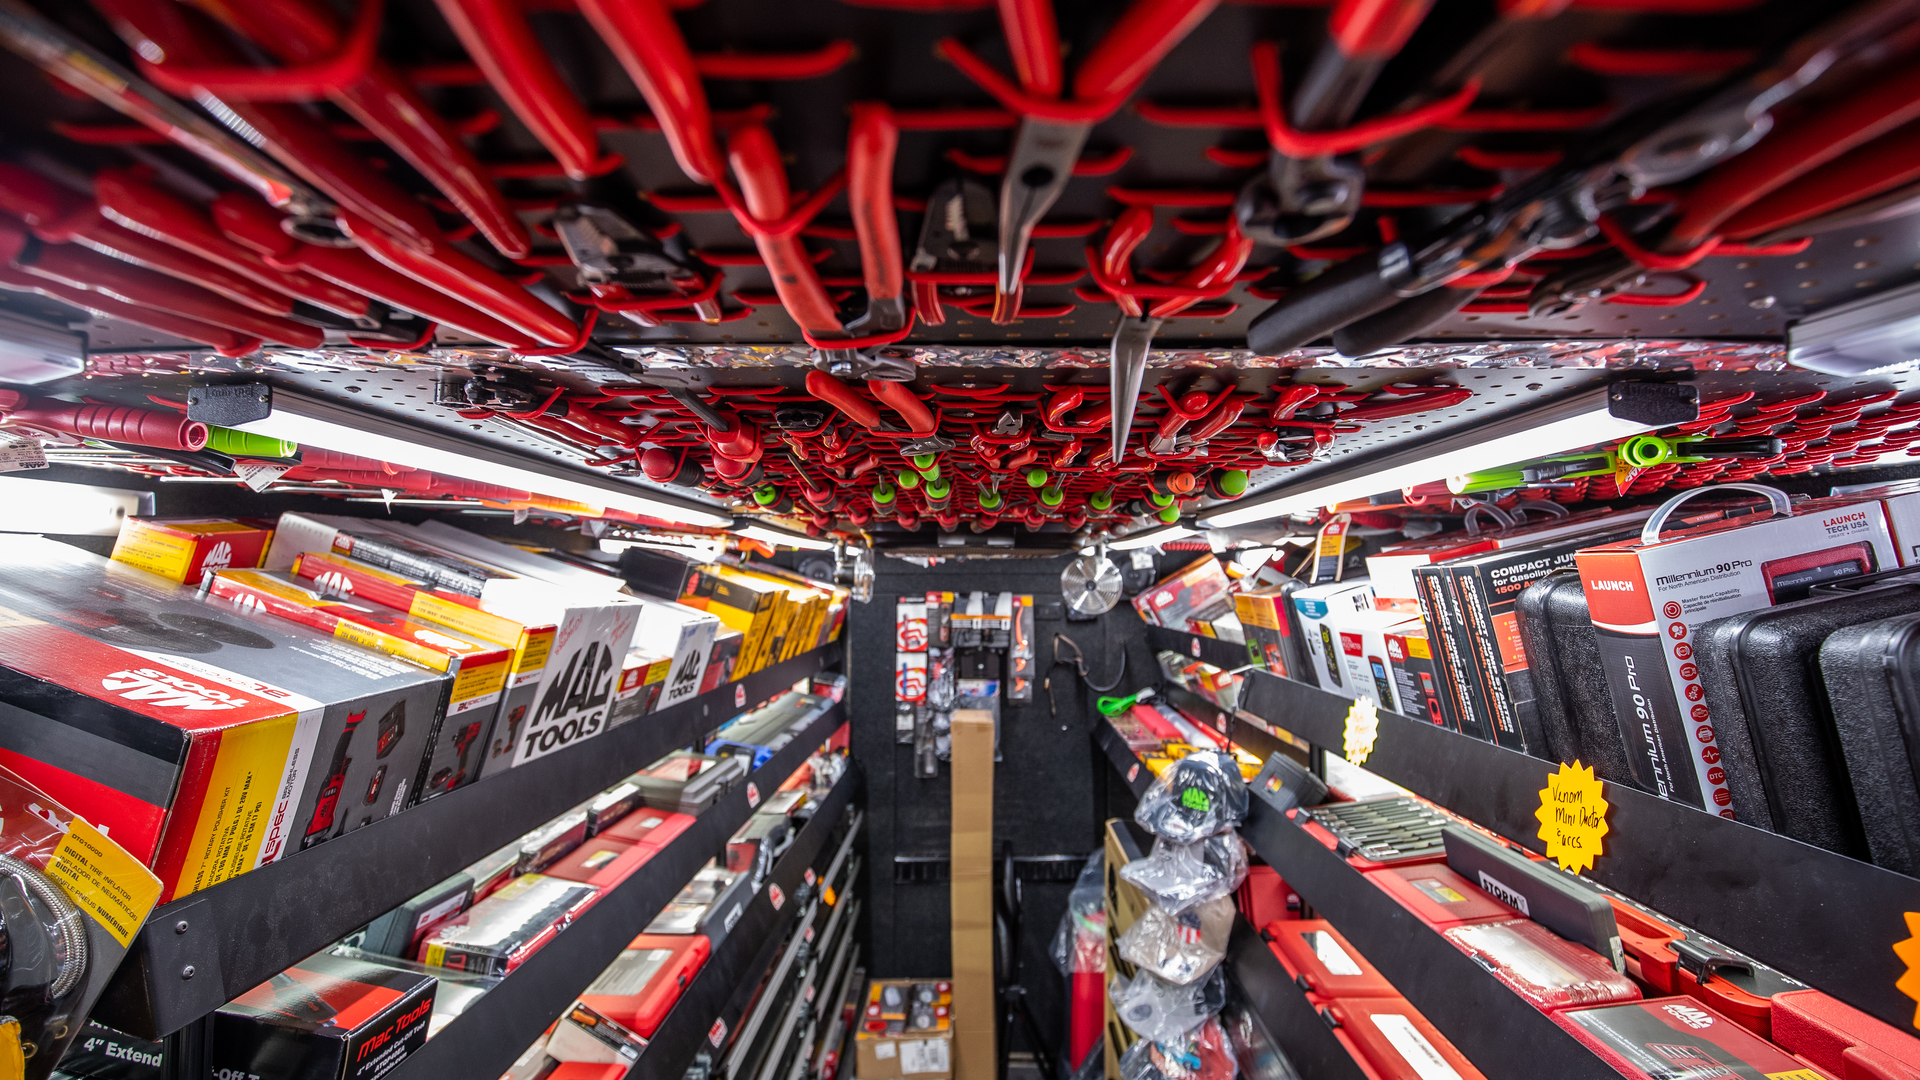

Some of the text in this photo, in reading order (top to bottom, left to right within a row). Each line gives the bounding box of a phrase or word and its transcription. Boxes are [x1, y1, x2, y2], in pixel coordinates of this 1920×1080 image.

[1823, 511, 1866, 528] LAUNCH
[1826, 520, 1868, 534] TECH USA
[1828, 532, 1845, 540] CREATE
[202, 541, 232, 566] MAC
[1490, 558, 1551, 579] COMPACT
[1492, 578, 1508, 587] for
[1509, 568, 1552, 584] Gasoline
[1656, 558, 1753, 586] Millennium 90 Pro
[1668, 582, 1684, 590] North
[1684, 576, 1710, 588] American
[1710, 570, 1741, 582] Distribution
[1843, 566, 1856, 574] Pro
[1495, 584, 1522, 595] 1500
[1590, 580, 1634, 592] LAUNCH
[1681, 588, 1740, 604] Master Reset Capability
[1684, 605, 1707, 615] principale
[1433, 576, 1452, 632] COMPACT
[1450, 634, 1461, 670] JUMP
[1458, 671, 1476, 722] STARTER
[1468, 575, 1514, 734] COMPACT JUMP STARTER
[672, 648, 700, 688] MAC
[1624, 656, 1641, 692] Pro
[102, 669, 238, 710] MAC
[133, 668, 250, 708] TOOLS
[530, 641, 613, 728] MAC
[668, 682, 694, 700] TOOLS
[1632, 694, 1650, 720] 90
[1647, 698, 1659, 734] Distribution
[524, 710, 602, 759] TOOLS
[1657, 734, 1667, 764] American
[287, 768, 298, 798] MOTOR
[1709, 772, 1724, 780] DTC
[240, 790, 248, 804] 20V
[1182, 787, 1209, 806] MAC
[1552, 783, 1582, 804] Venom
[238, 804, 244, 812] DE
[205, 833, 216, 859] ROTARY
[214, 798, 227, 832] POLISHER
[241, 810, 253, 840] ROTATIVE
[243, 842, 250, 852] DE
[249, 820, 256, 832] CM
[218, 826, 230, 858] ROTATIVA
[222, 844, 230, 858] MM
[56, 860, 79, 882] DIGITAL
[60, 856, 91, 881] INFLADOR
[92, 878, 100, 888] DE
[64, 846, 132, 902] DIGITAL TIRE INFLATOR
[214, 872, 221, 882] DE
[1482, 878, 1520, 911] STORM
[96, 906, 129, 939] NUMÉRIQUE
[1660, 1004, 1715, 1028] MAC
[1662, 1005, 1701, 1030] TOOLS
[356, 998, 432, 1062] Mac Tools
[84, 1037, 164, 1068] 4" Extend
[365, 1045, 394, 1071] Extended
[394, 1030, 414, 1049] Cut-Off
[414, 1020, 426, 1034] Tool
